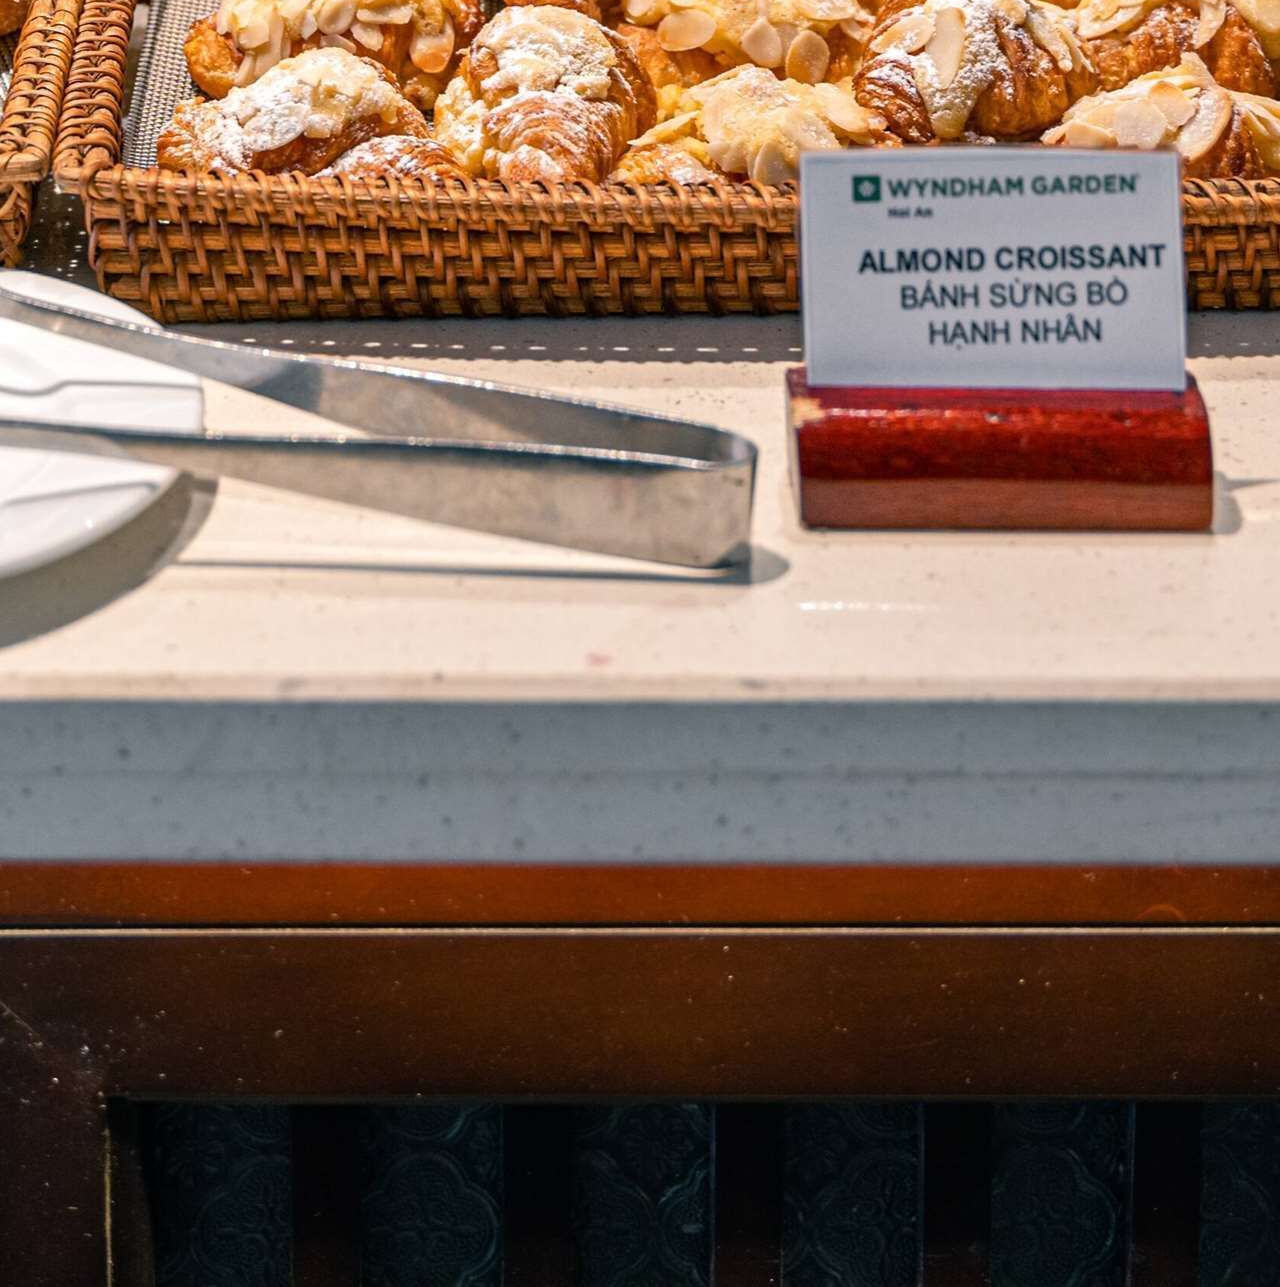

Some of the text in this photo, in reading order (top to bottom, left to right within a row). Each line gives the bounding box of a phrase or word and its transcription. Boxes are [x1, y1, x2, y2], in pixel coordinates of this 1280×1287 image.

[888, 174, 1136, 197] WYNDHAM GARDEN
[859, 244, 1165, 273] ALMOND CROISSANT
[901, 280, 979, 310] BÁNH
[1087, 277, 1128, 306] BÒ
[929, 314, 1102, 351] HẠNH NHÂN
